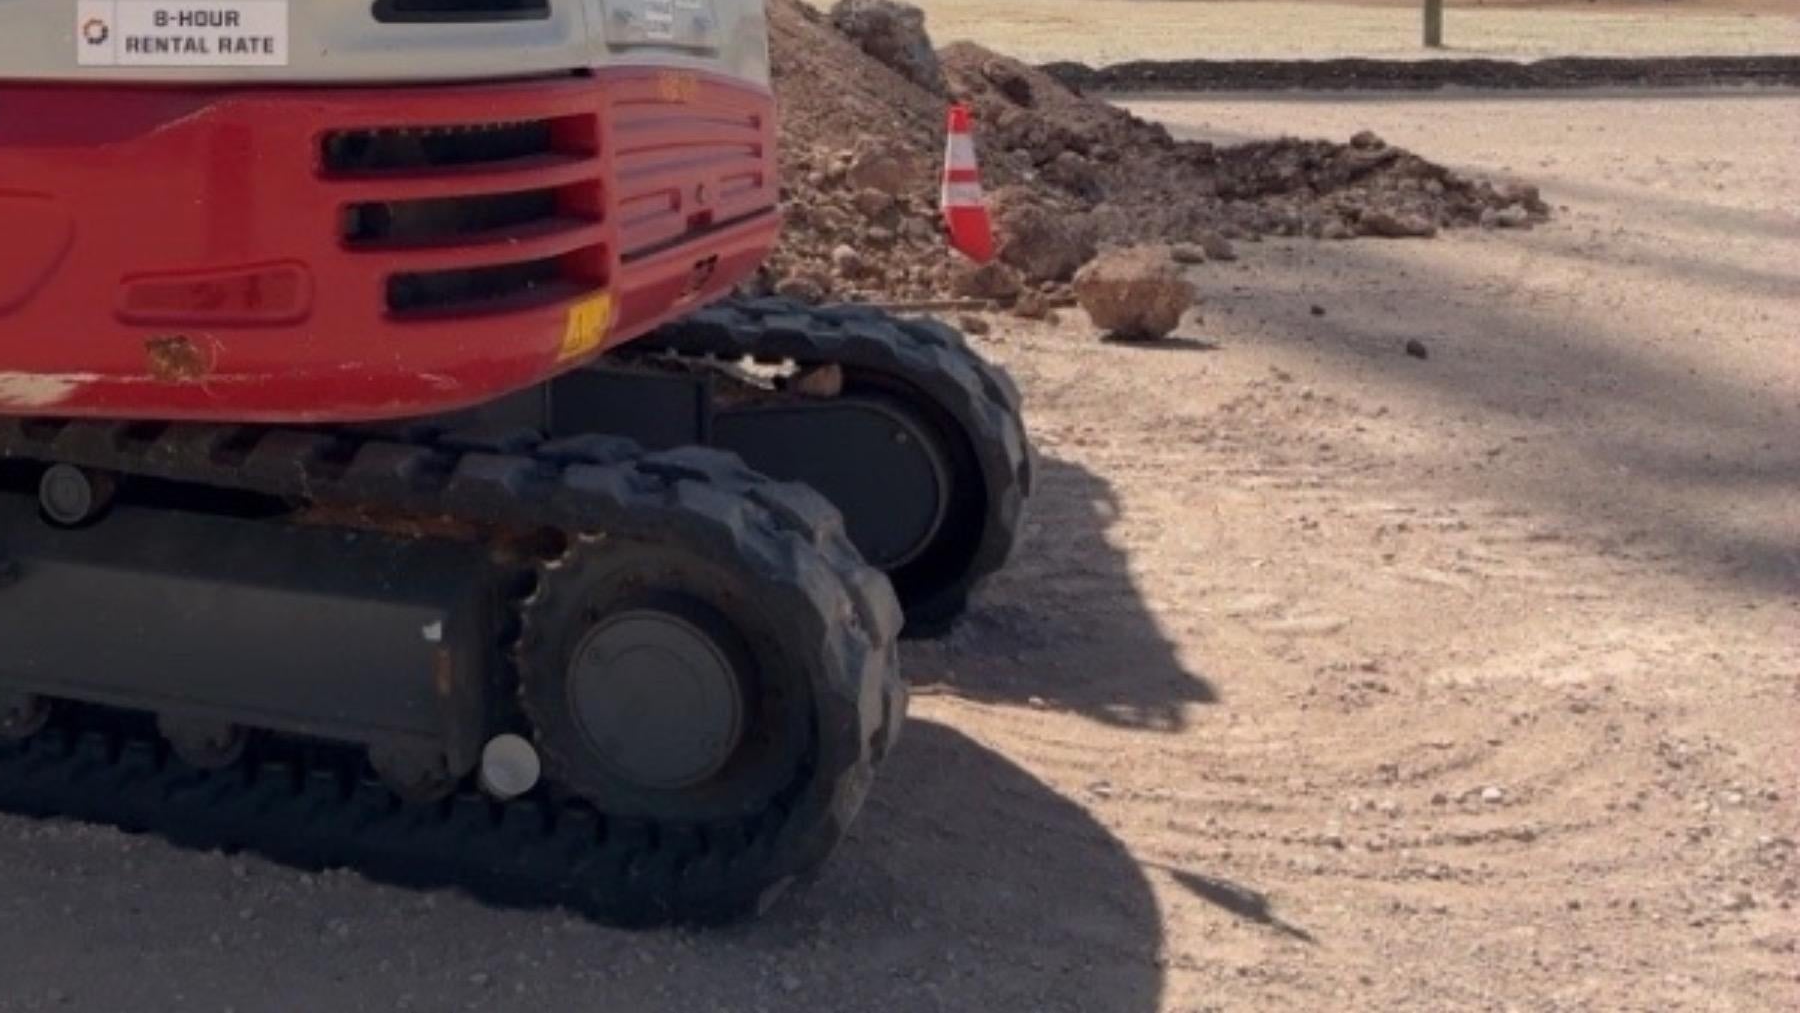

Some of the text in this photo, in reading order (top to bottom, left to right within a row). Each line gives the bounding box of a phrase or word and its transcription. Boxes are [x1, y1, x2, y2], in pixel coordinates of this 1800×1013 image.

[153, 10, 241, 28] 8-HOUR
[125, 35, 275, 54] RENTAL RATE
